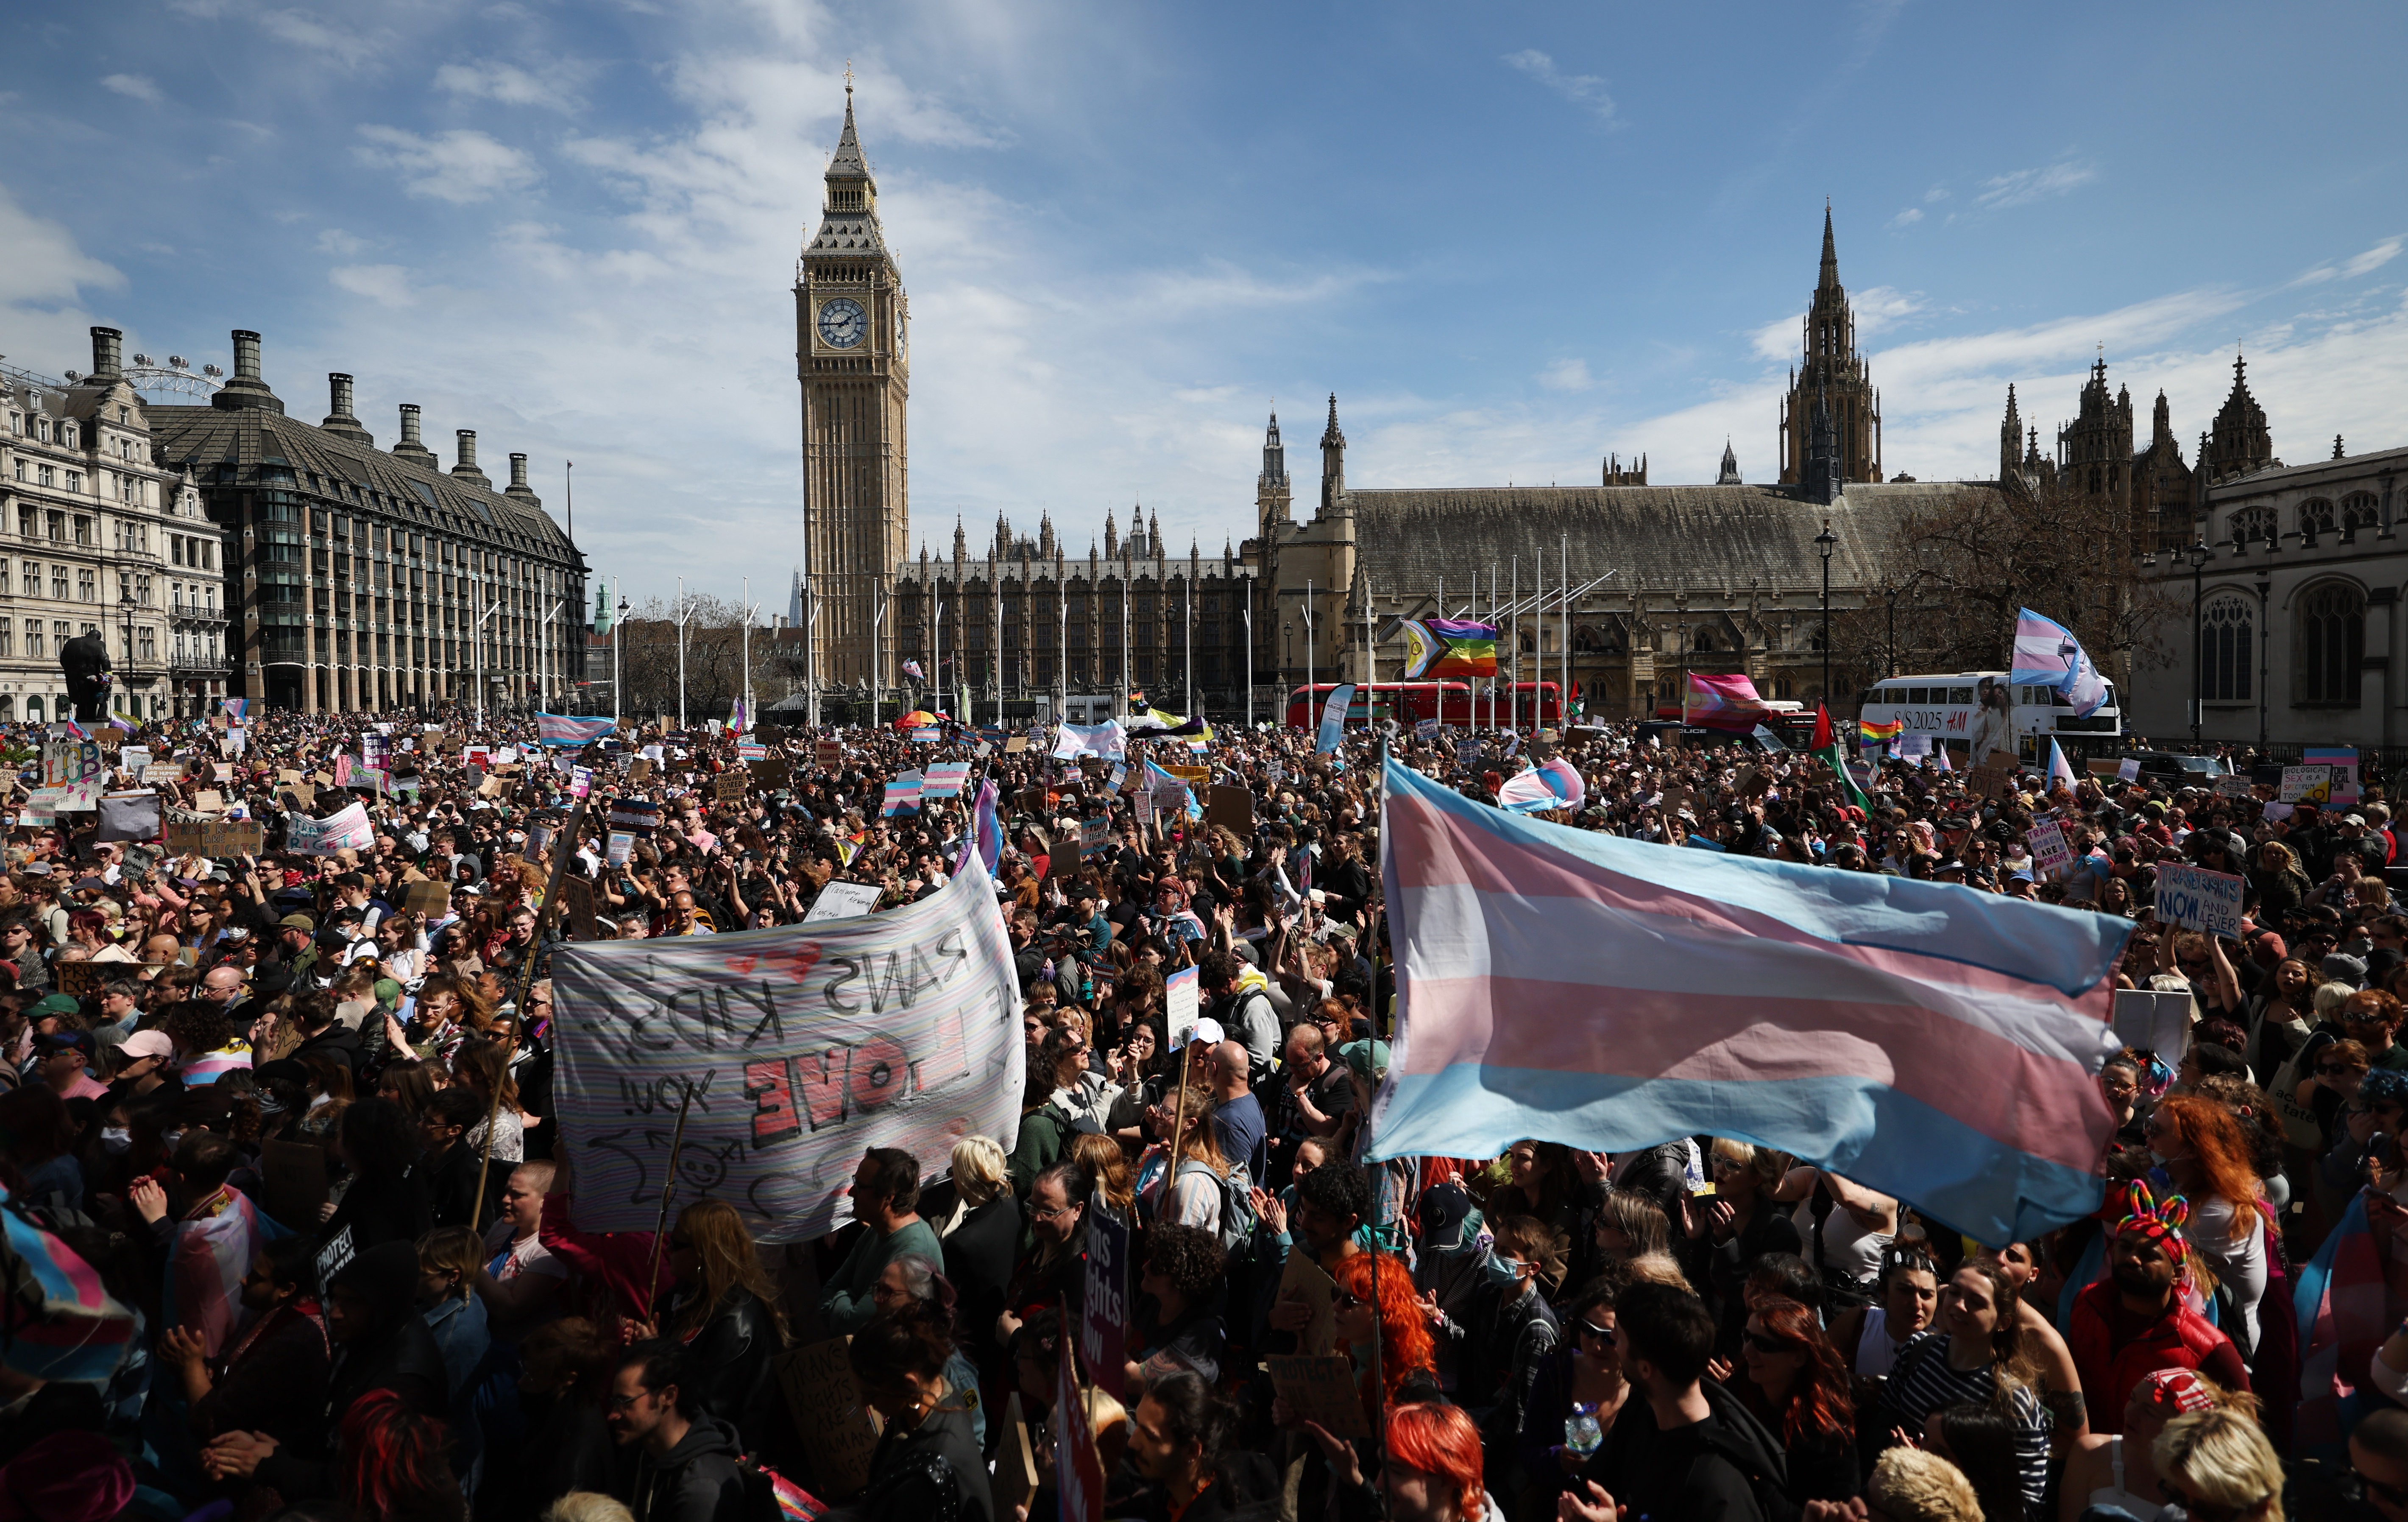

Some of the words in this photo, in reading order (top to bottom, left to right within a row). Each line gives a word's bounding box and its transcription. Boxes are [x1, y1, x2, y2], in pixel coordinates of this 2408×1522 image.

[1327, 703, 1346, 712] education
[1894, 709, 1912, 729] S/S
[1913, 712, 1943, 730] 2025
[1946, 711, 1968, 733] H&M
[2099, 720, 2110, 728] 87
[364, 737, 382, 746] Trans
[1419, 731, 1437, 740] EXISTED
[364, 746, 387, 757] Rights
[617, 752, 632, 760] PROTECT
[365, 757, 379, 765] Now
[573, 768, 587, 779] Trans
[1973, 767, 2004, 781] ILLEGAL
[2285, 774, 2303, 782] SEX
[571, 776, 589, 788] Rights
[719, 781, 743, 789] SCARED
[1159, 778, 1171, 787] OUR
[1974, 776, 2001, 795] DYKE
[570, 784, 581, 793] Now
[55, 795, 70, 805] THE
[632, 808, 650, 817] SPACE
[172, 824, 210, 835] TRANS
[216, 823, 259, 835] RIGHTS
[293, 817, 332, 833] TRANS
[615, 819, 624, 827] FOR
[1088, 820, 1106, 832] TRANS
[1088, 830, 1107, 842] RIGHTS
[2026, 823, 2058, 840] TRANS
[205, 835, 226, 844] ARE
[290, 831, 363, 850] RIGHTS
[1093, 841, 1105, 850] NOW
[2030, 834, 2062, 851] WOMEN
[173, 846, 209, 857] HUMAN
[213, 843, 257, 857] RIGHTS
[2040, 845, 2058, 857] ARE
[132, 853, 143, 862] ARE
[122, 859, 143, 872] HUMAN
[120, 866, 144, 881] RIGHTS!
[2160, 865, 2199, 890] TRANS
[2198, 873, 2241, 902] RIGHTS
[810, 905, 826, 918] Trans
[2159, 890, 2199, 921] NOW
[2203, 899, 2229, 916] AND
[2199, 910, 2237, 932] 4EVER
[2283, 1103, 2316, 1124] tate
[317, 1224, 354, 1276] PROTECT
[782, 1343, 847, 1390] TRANS
[1270, 1357, 1335, 1382] PROTECT
[795, 1377, 855, 1417] RIGHTS
[815, 1406, 846, 1435] ARE
[810, 1421, 872, 1461] HUMAN
[828, 1448, 875, 1480] RIGHT
